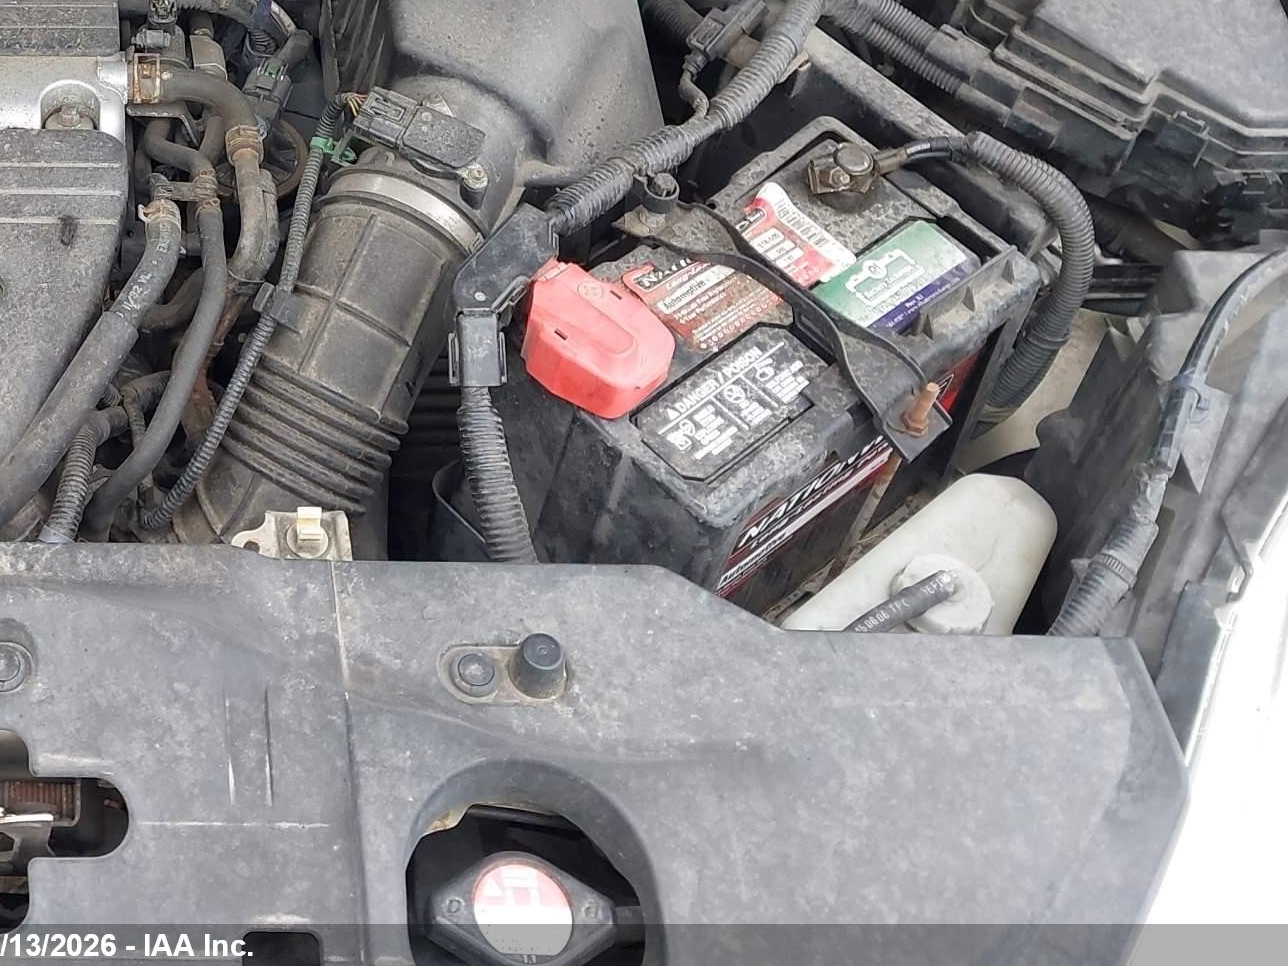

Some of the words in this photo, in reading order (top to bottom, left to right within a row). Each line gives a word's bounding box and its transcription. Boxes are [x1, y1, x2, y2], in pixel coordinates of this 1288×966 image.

[662, 276, 705, 310] Automotive
[676, 377, 719, 412] DANGER
[723, 346, 762, 378] POISON
